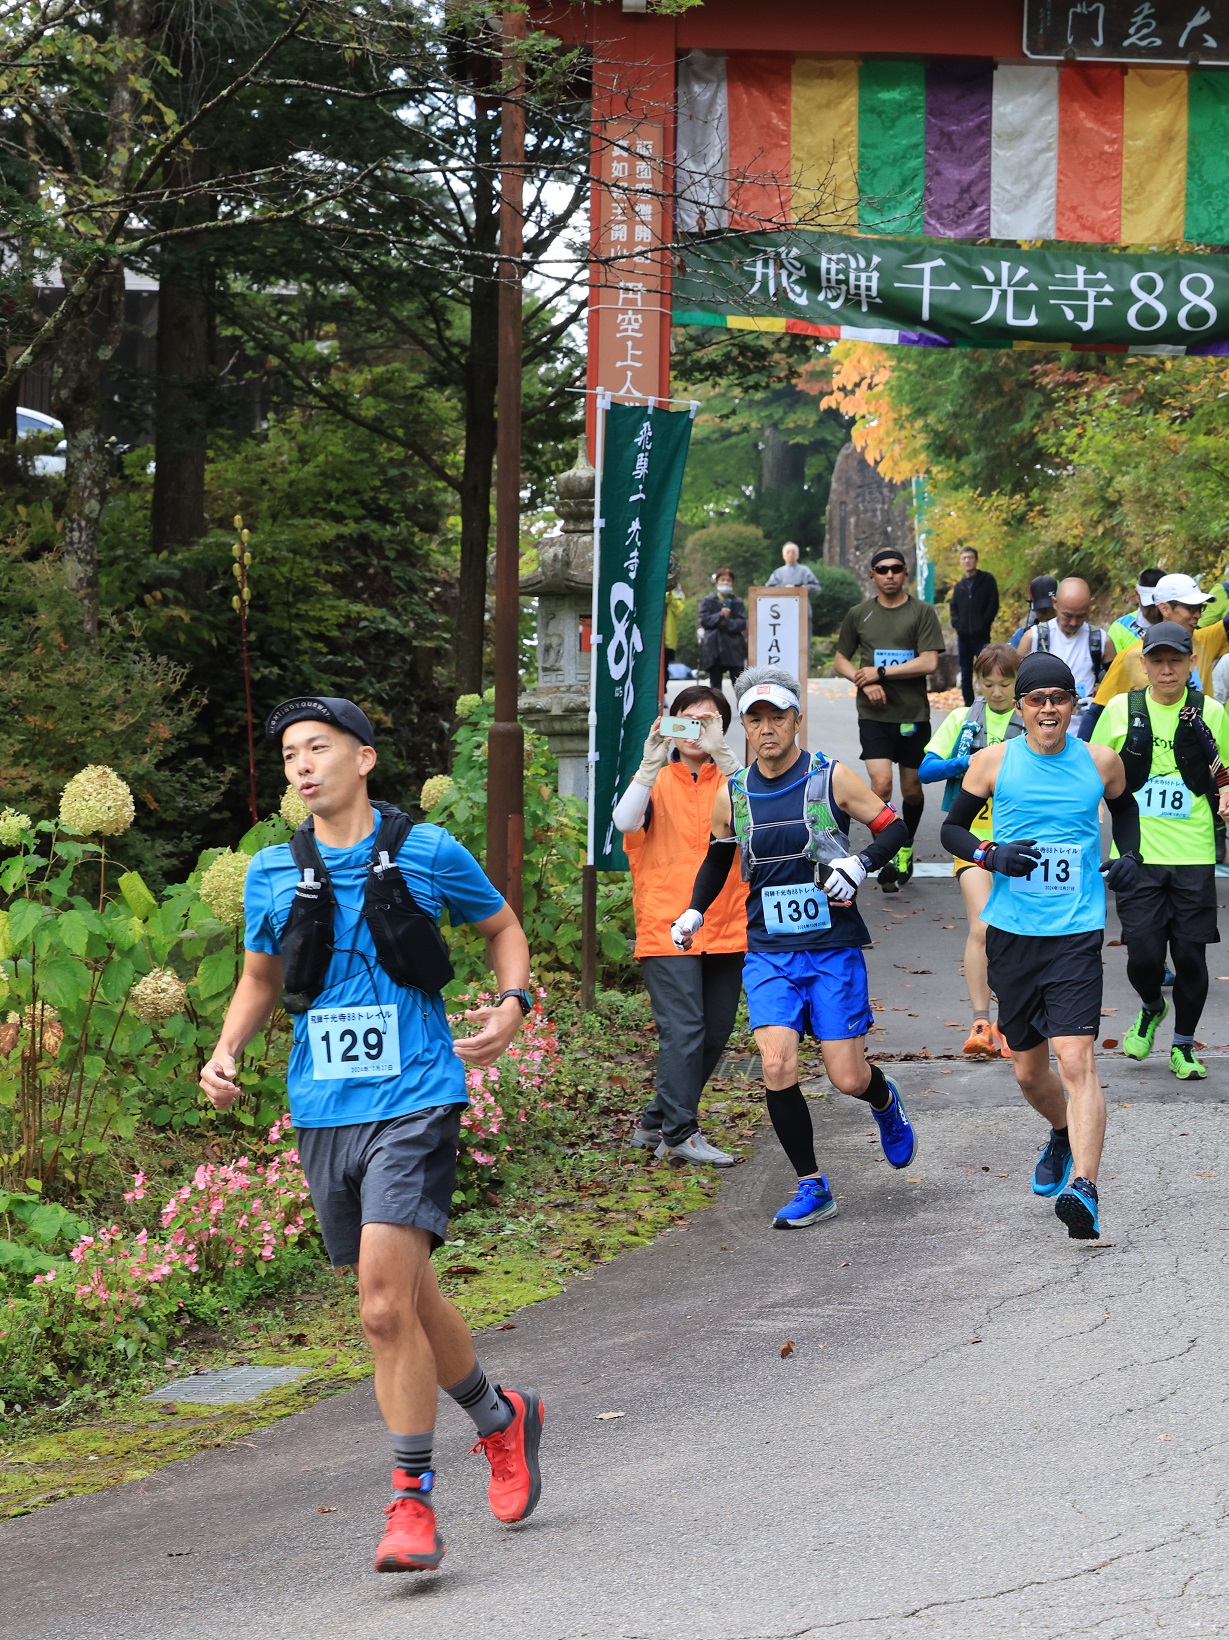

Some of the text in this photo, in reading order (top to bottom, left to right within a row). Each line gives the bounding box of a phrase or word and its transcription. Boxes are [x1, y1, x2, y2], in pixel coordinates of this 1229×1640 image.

[615, 281, 644, 406] 円空上人
[768, 603, 782, 666] STAR
[978, 802, 992, 820] 2
[1145, 788, 1184, 810] 118
[773, 897, 819, 924] 130
[321, 1027, 384, 1063] 129
